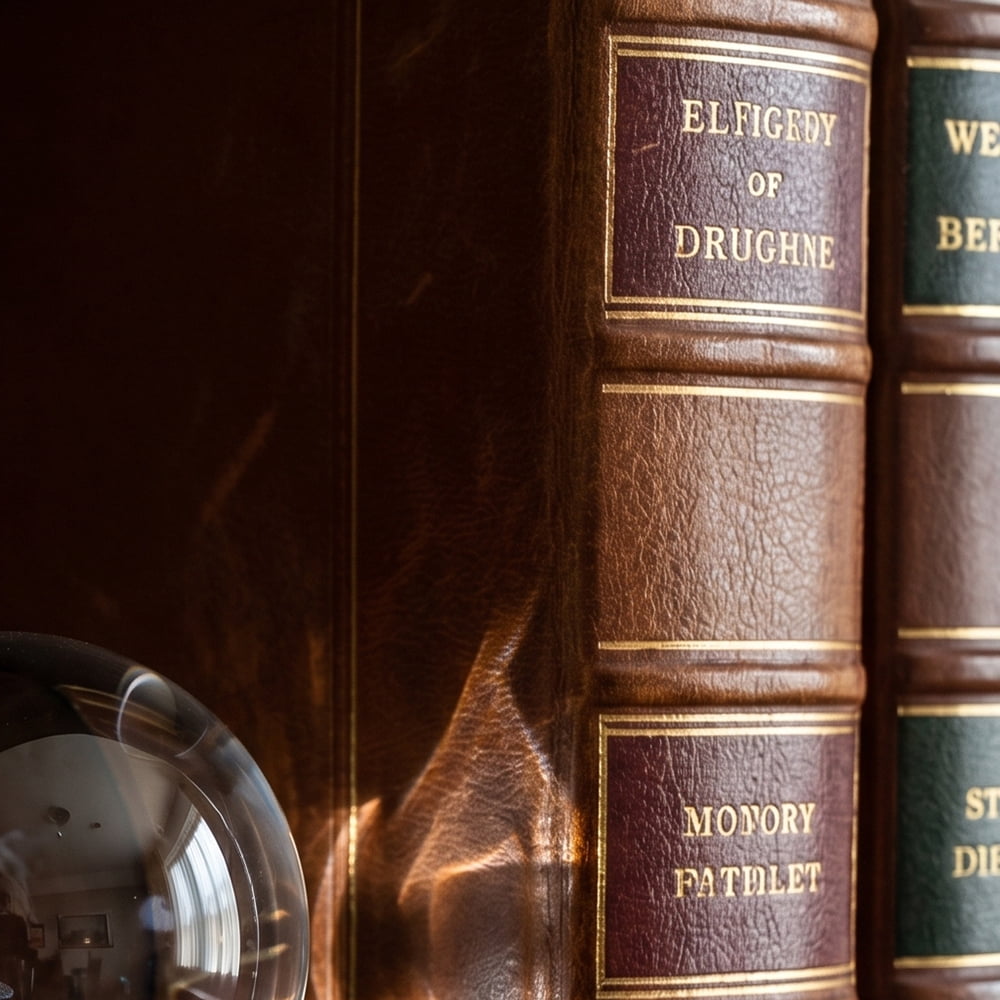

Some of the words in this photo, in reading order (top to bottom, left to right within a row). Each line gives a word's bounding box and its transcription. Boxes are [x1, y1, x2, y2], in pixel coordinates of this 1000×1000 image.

[944, 118, 1000, 157] WE
[748, 172, 783, 198] OF
[674, 225, 836, 270] DRUGHNE
